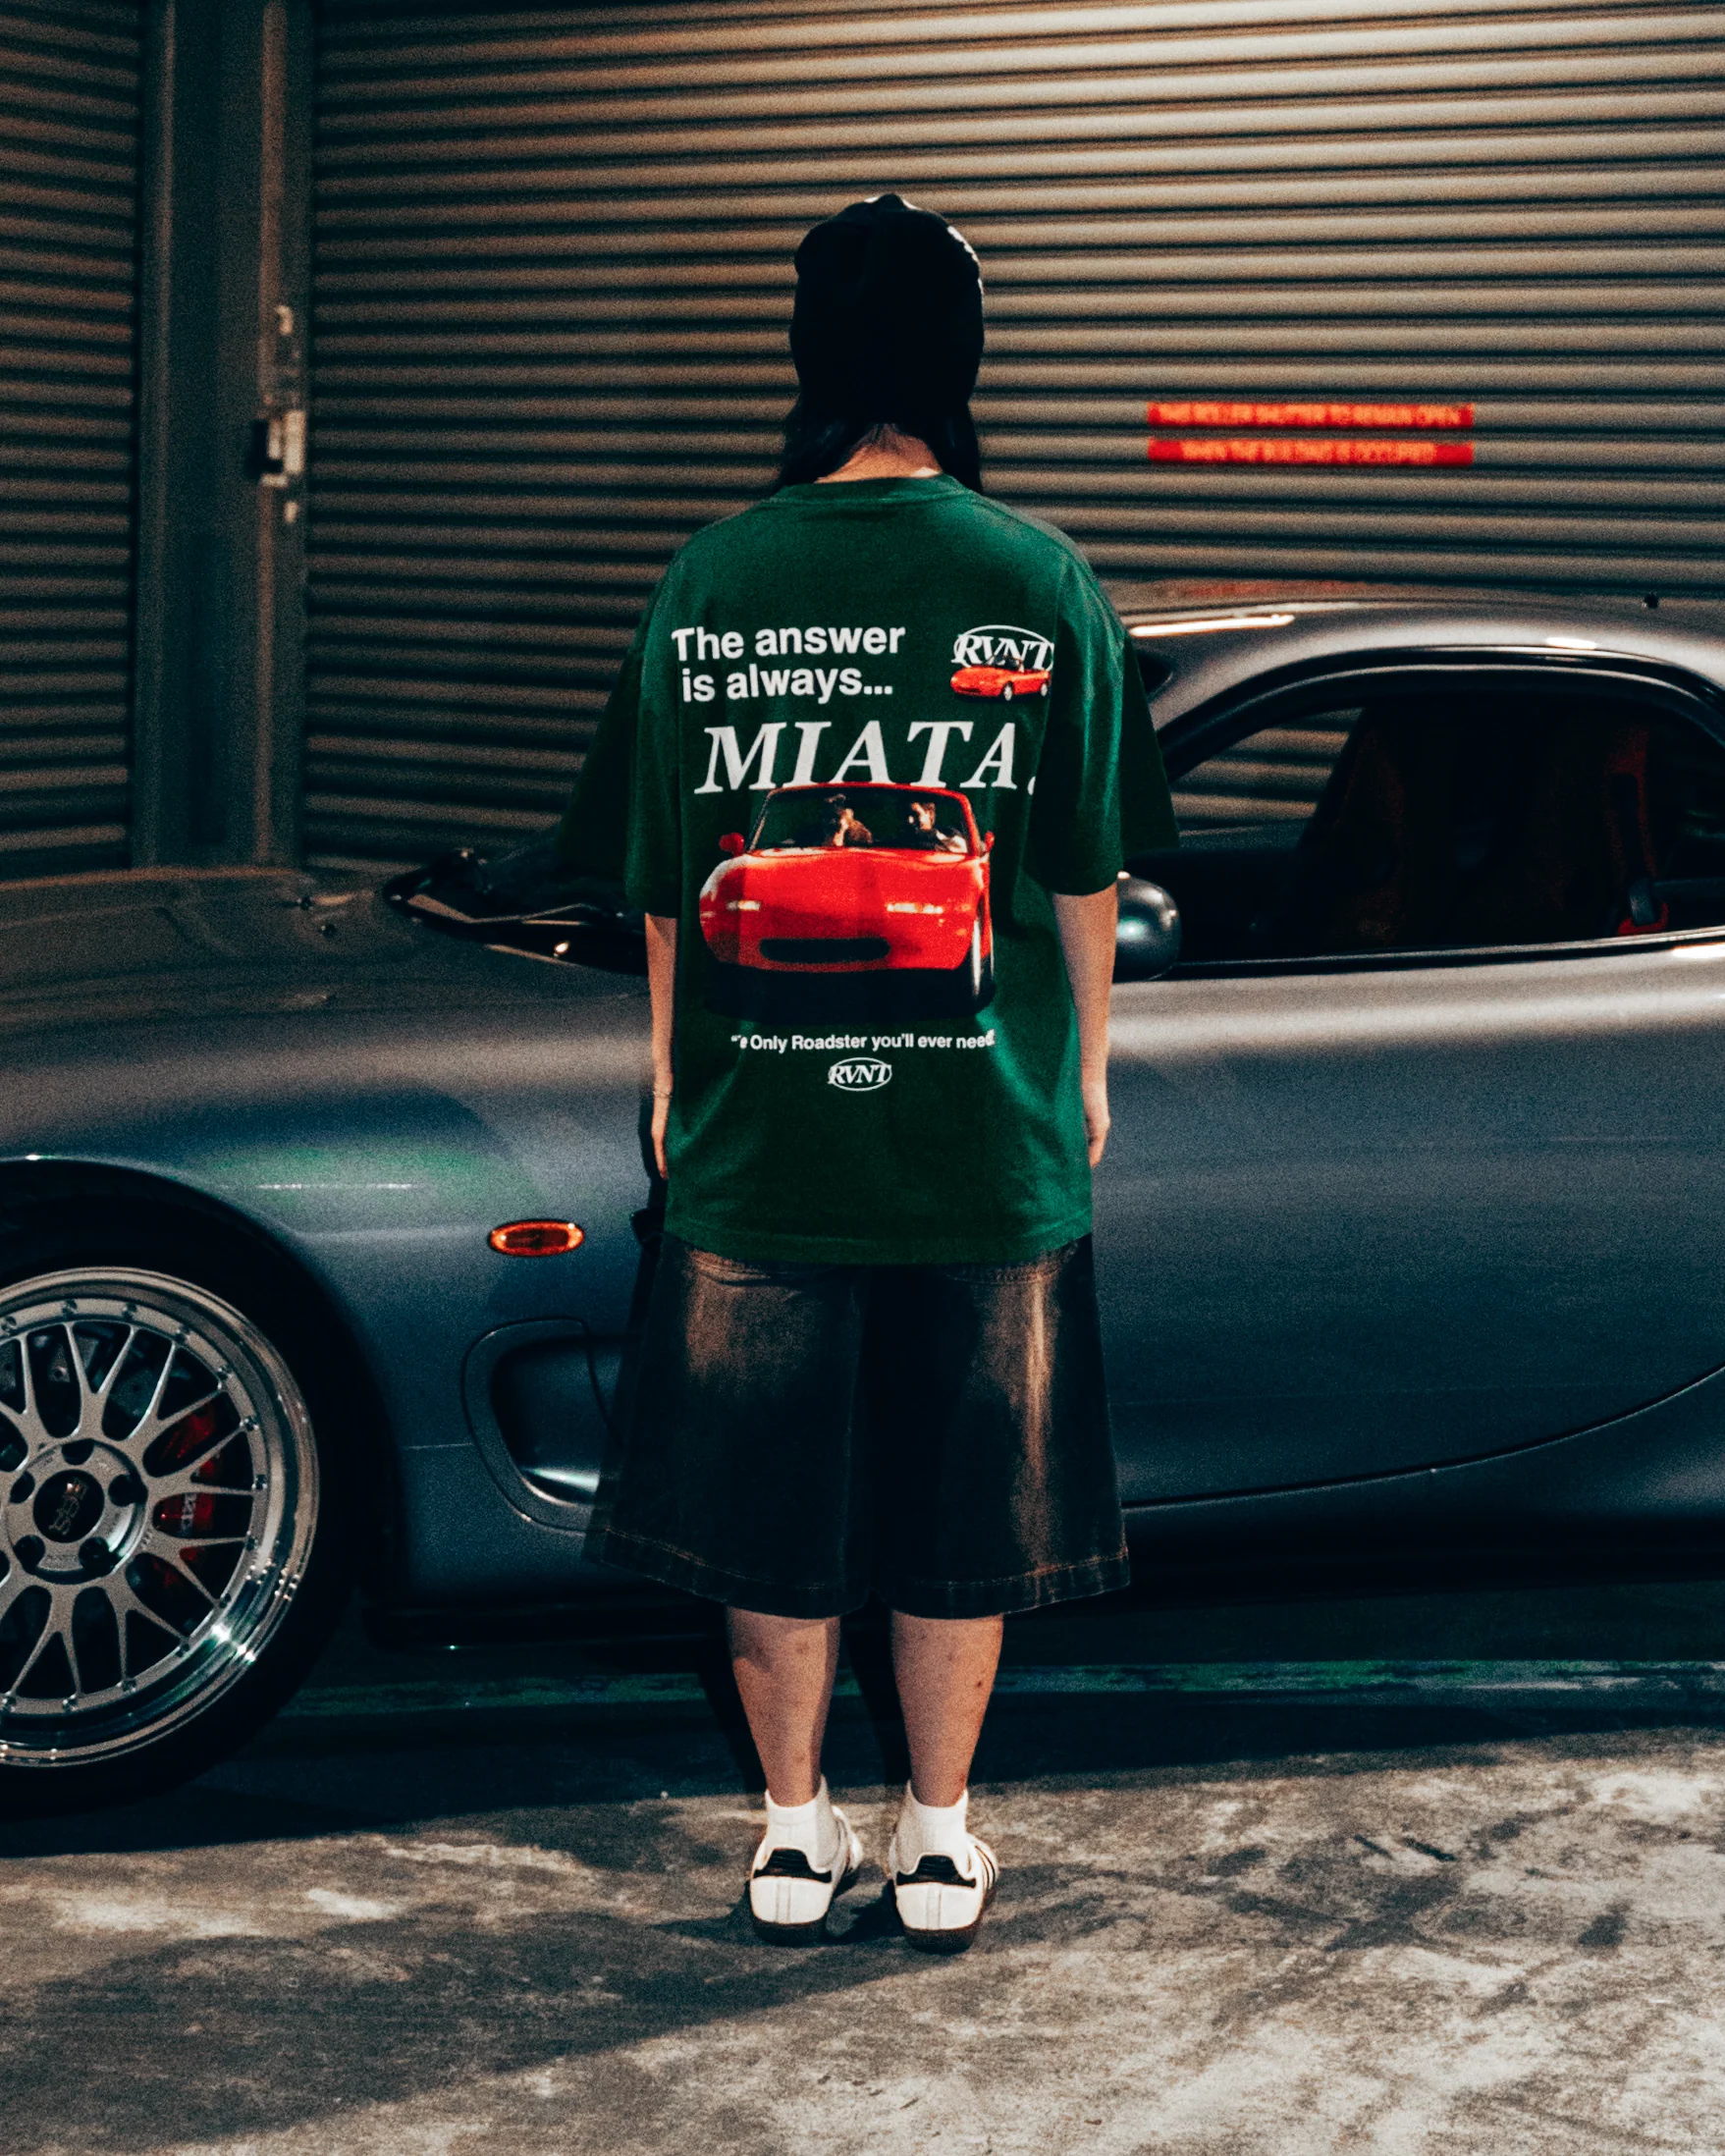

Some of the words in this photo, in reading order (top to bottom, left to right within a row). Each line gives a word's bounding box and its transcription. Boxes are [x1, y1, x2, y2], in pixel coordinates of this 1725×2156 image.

[671, 625, 744, 662] The
[754, 625, 906, 657] answer
[681, 668, 716, 703] is
[726, 663, 893, 705] always...
[749, 1034, 788, 1054] Only
[791, 1034, 868, 1051] Roadster
[871, 1033, 914, 1052] you'll
[917, 1036, 952, 1049] ever
[827, 1063, 893, 1086] RVNT
